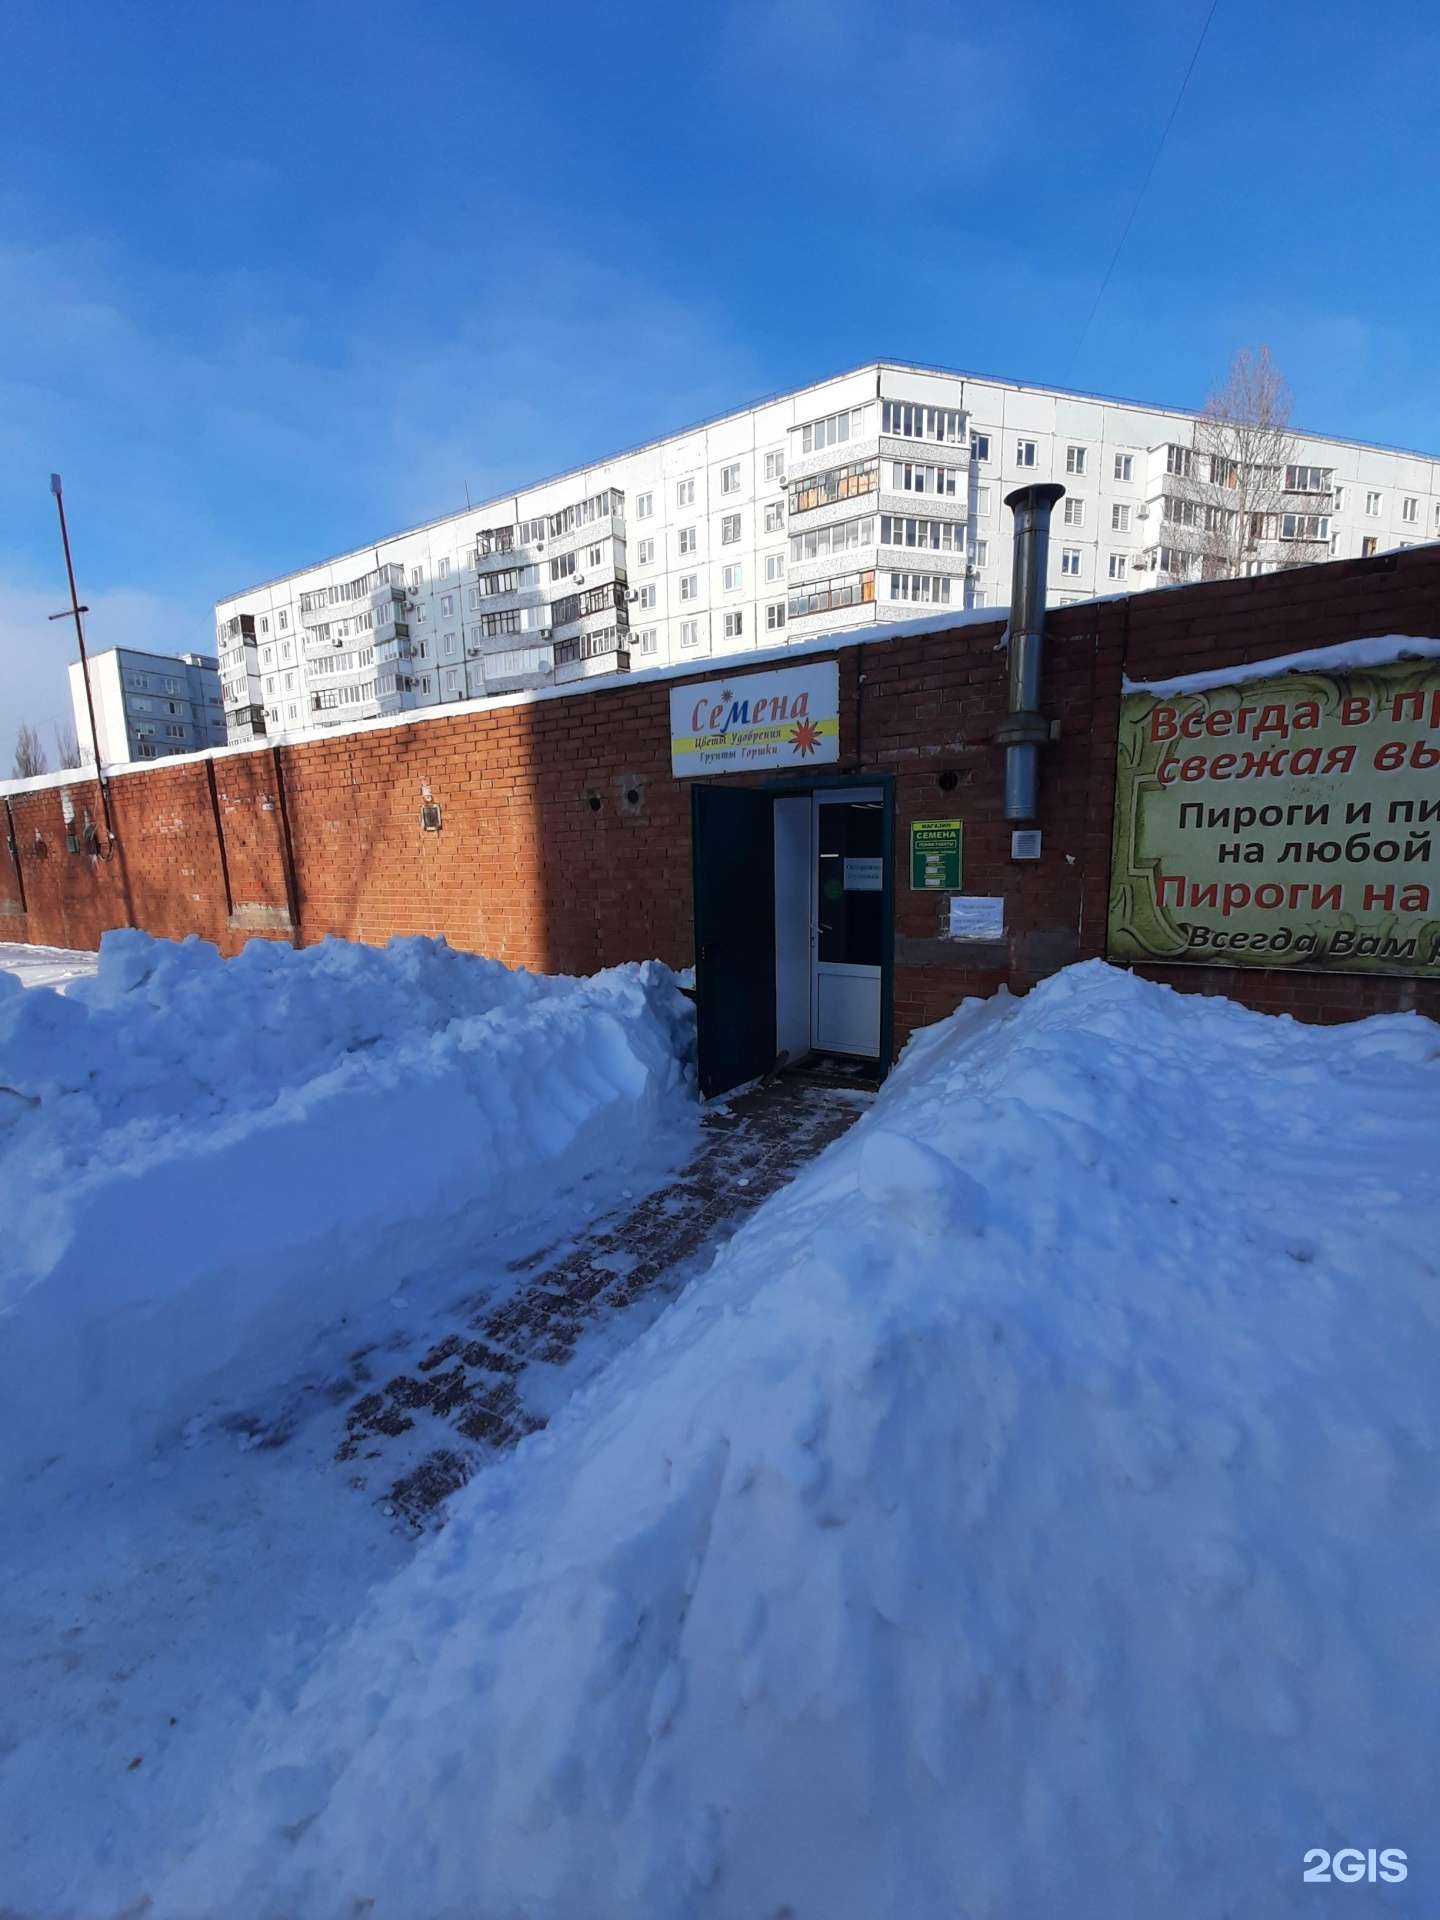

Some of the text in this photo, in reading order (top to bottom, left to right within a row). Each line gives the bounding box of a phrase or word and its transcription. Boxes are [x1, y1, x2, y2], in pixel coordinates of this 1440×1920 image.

[692, 692, 809, 733] Семена
[1150, 700, 1320, 742] Всегда
[1341, 696, 1371, 726] в
[695, 728, 781, 749] Цветы Удобрения
[700, 744, 778, 764] Грунты Горшки
[1157, 744, 1357, 784] свежая
[916, 830, 956, 839] СЕМЕНА
[1178, 801, 1330, 834] Пироги
[1345, 801, 1372, 824] и
[1218, 830, 1432, 864] на любой
[1155, 875, 1431, 917] Пироги на
[1187, 924, 1319, 954] Всегда
[1329, 929, 1418, 958] Вам
